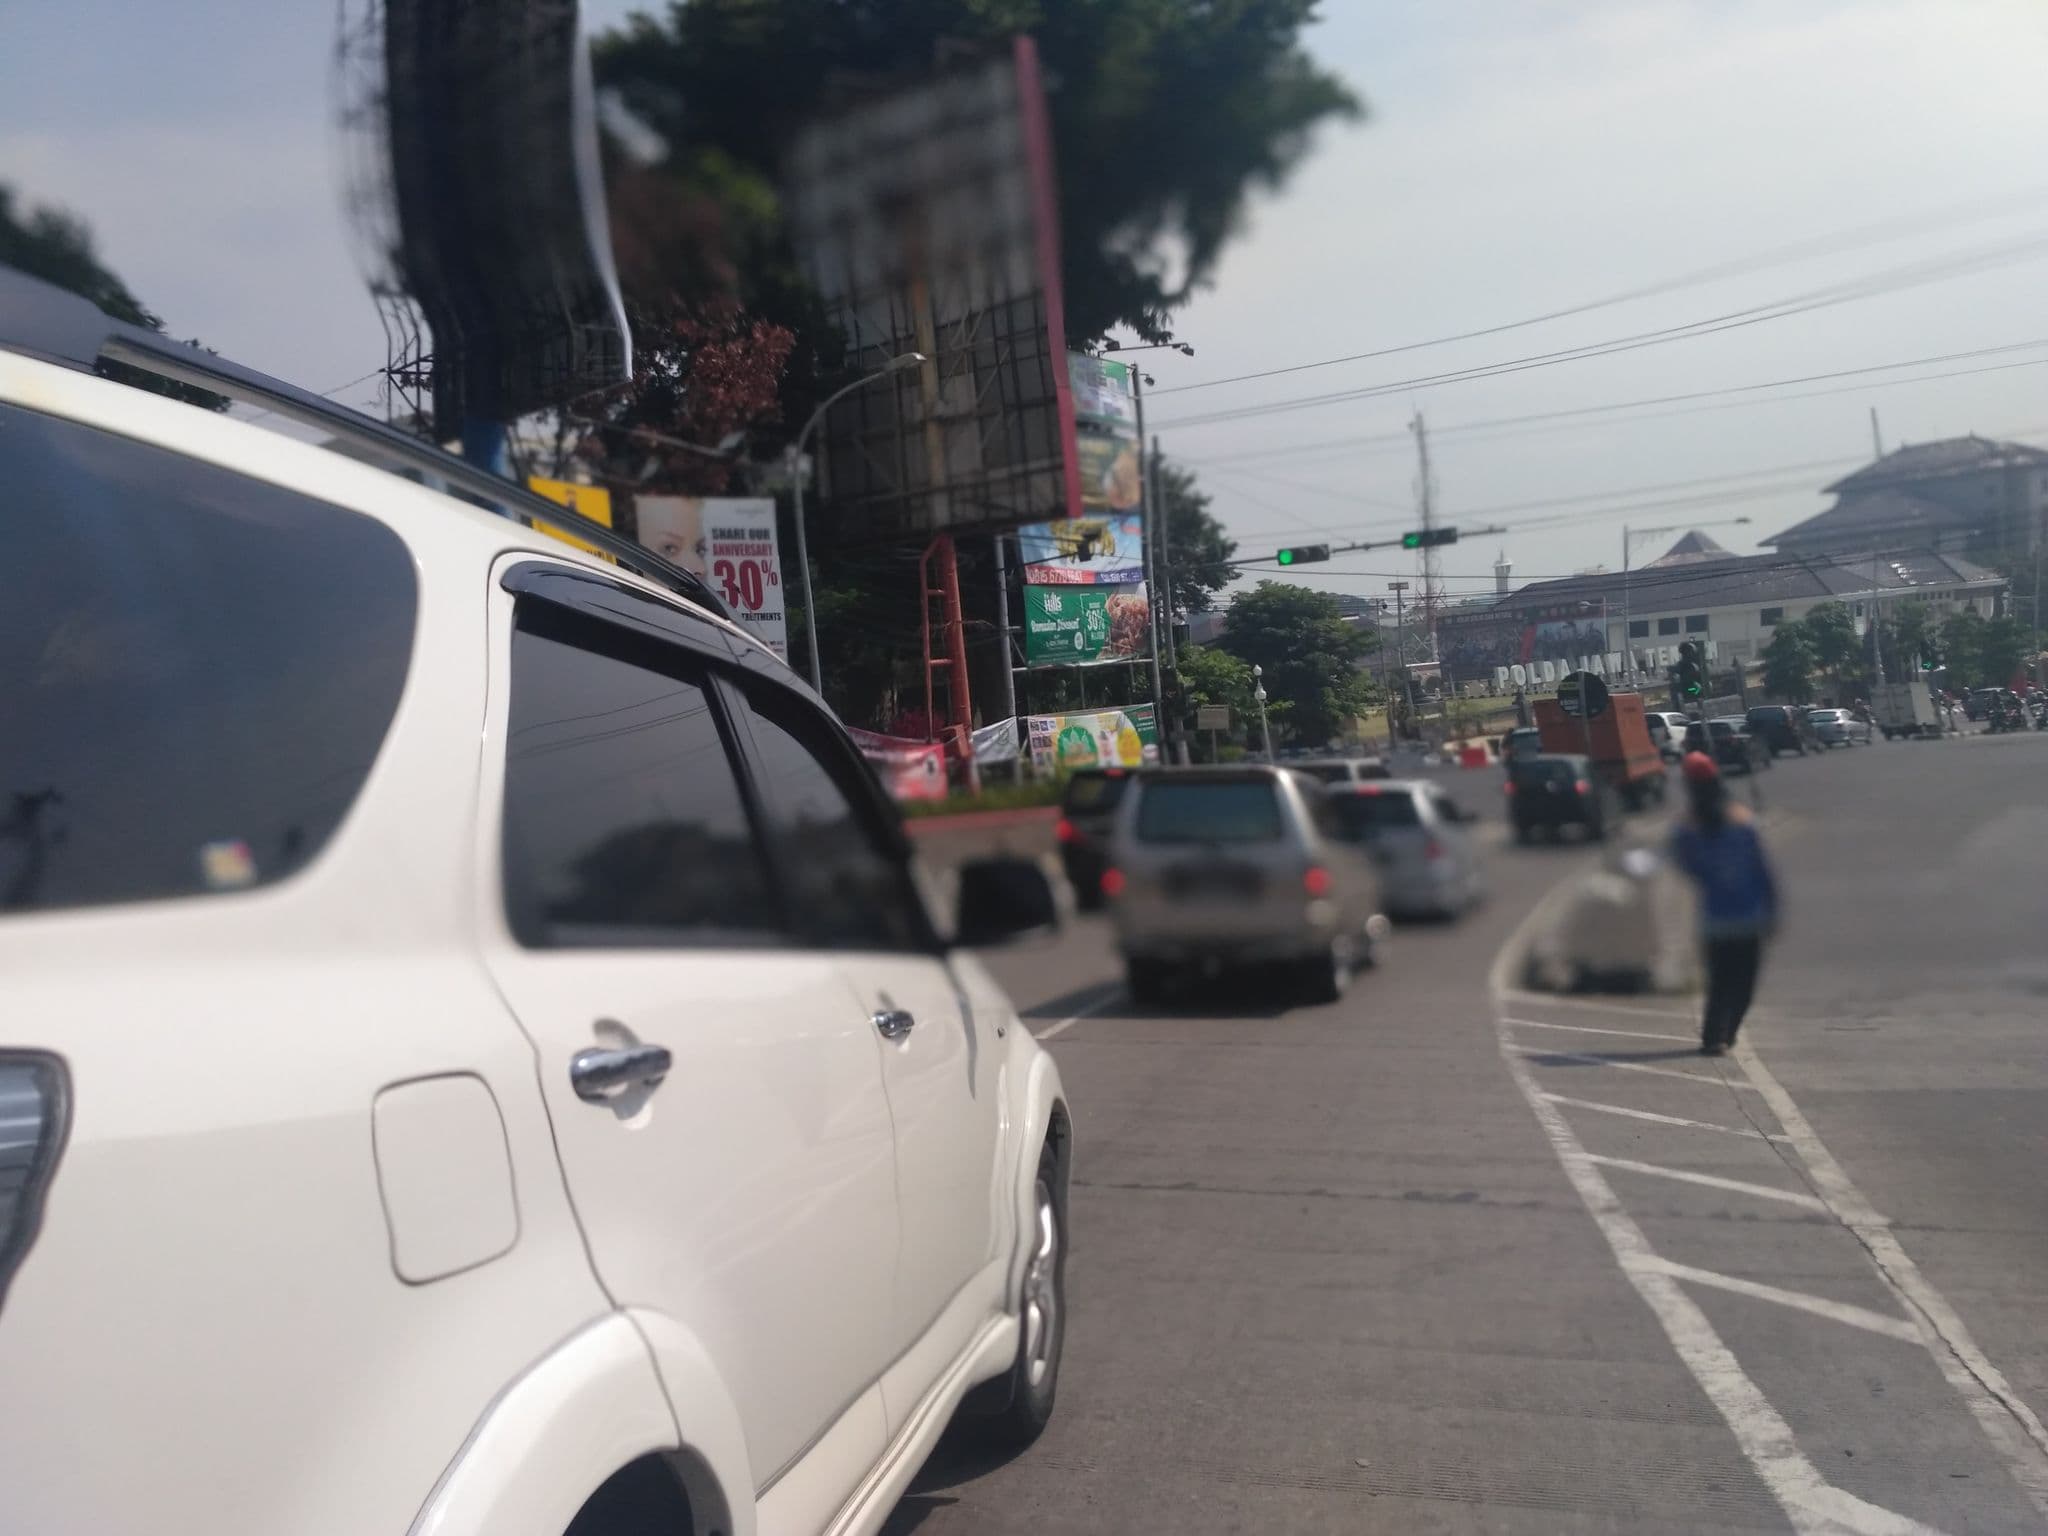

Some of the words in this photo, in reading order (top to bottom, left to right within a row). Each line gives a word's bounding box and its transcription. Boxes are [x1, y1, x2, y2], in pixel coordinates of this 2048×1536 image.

[711, 528, 745, 540] SHARE
[749, 528, 770, 540] OUR
[712, 543, 773, 556] ANNIVERSARY
[713, 559, 778, 611] 30%
[1496, 660, 1571, 689] POLDA
[1647, 641, 1719, 667] TENH
